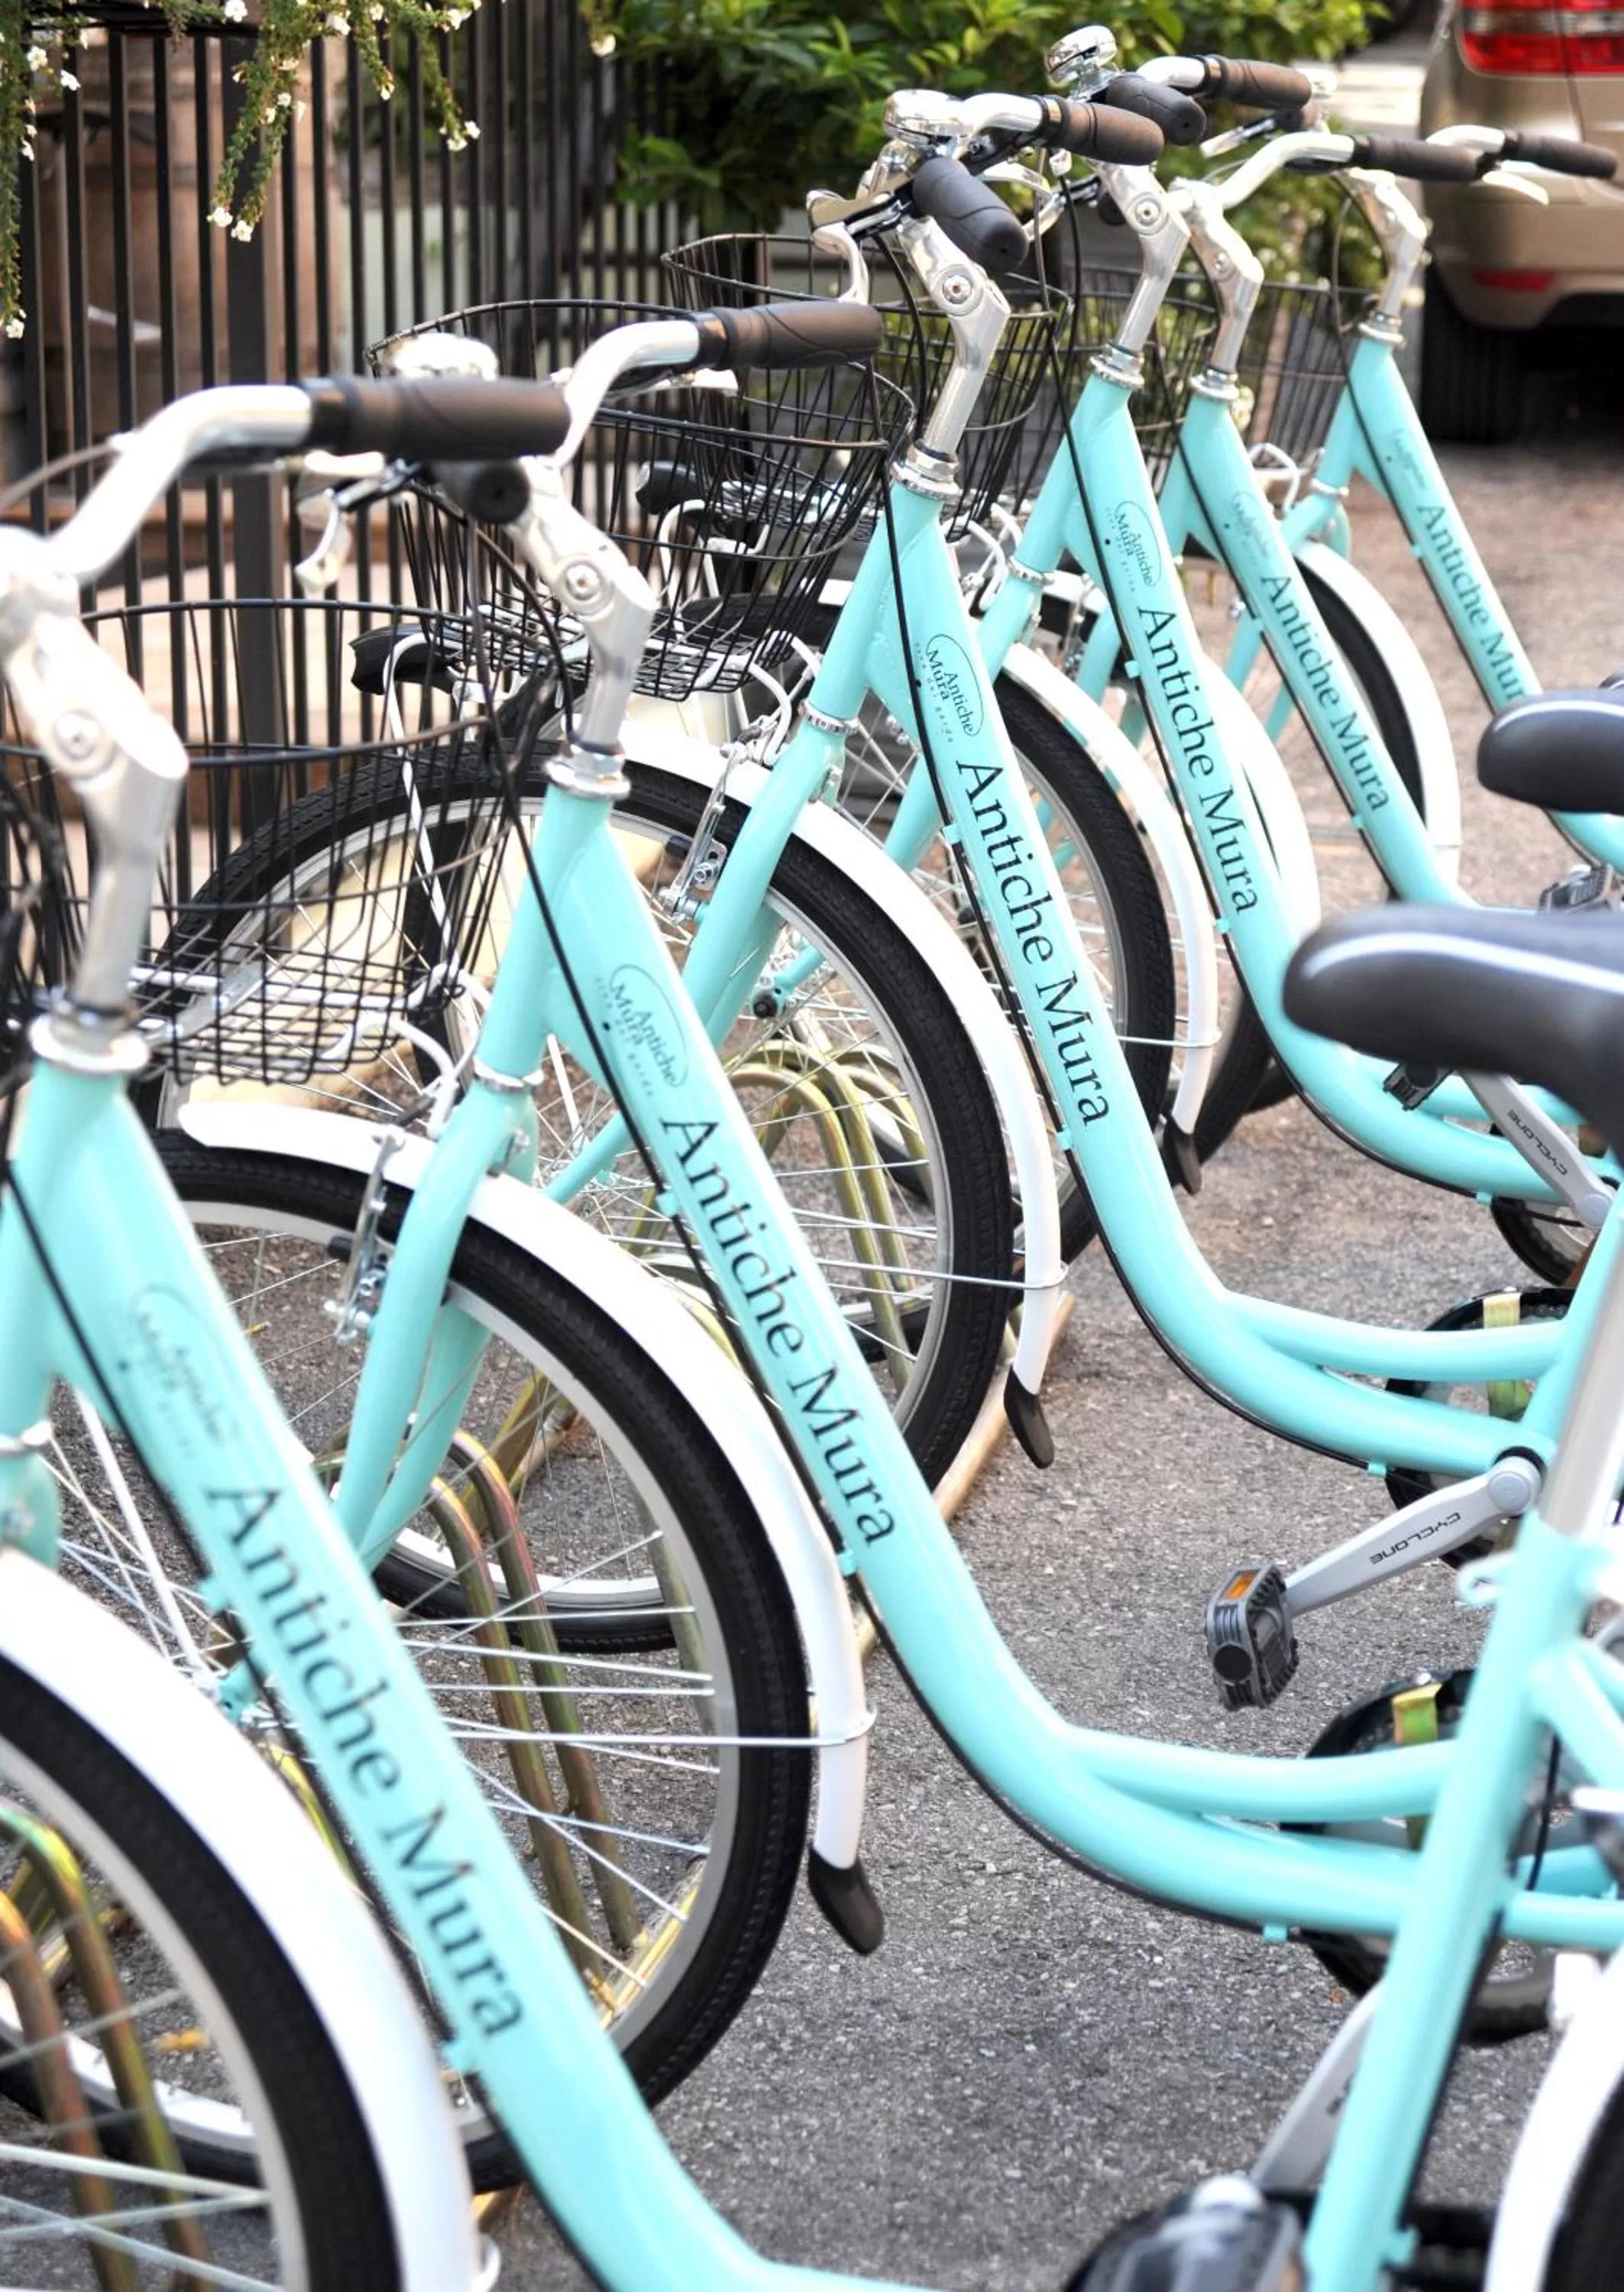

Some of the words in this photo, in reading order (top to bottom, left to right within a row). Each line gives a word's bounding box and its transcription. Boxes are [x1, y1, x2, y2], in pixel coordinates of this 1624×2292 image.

[1115, 513, 1134, 556] Mura
[1130, 533, 1153, 583] Antiche
[1416, 507, 1490, 625] Antiche
[1480, 631, 1526, 701] Mur
[927, 649, 949, 701] Mura
[943, 672, 974, 732] Antiche
[1260, 577, 1338, 708] Antiche
[1330, 712, 1389, 811] Mura
[1137, 607, 1215, 778] Antiche
[1199, 785, 1258, 914] Mura
[956, 759, 1053, 965] Antiche
[1035, 971, 1111, 1126] Mura
[634, 1011, 677, 1082] Antiche
[1508, 1109, 1567, 1175] CYCLONE
[662, 1119, 804, 1358] Antiche
[788, 1362, 895, 1546] Mura
[1369, 1512, 1461, 1564] CYCLONE
[205, 1481, 401, 1797] Antiche
[381, 1803, 523, 2039] Mura
